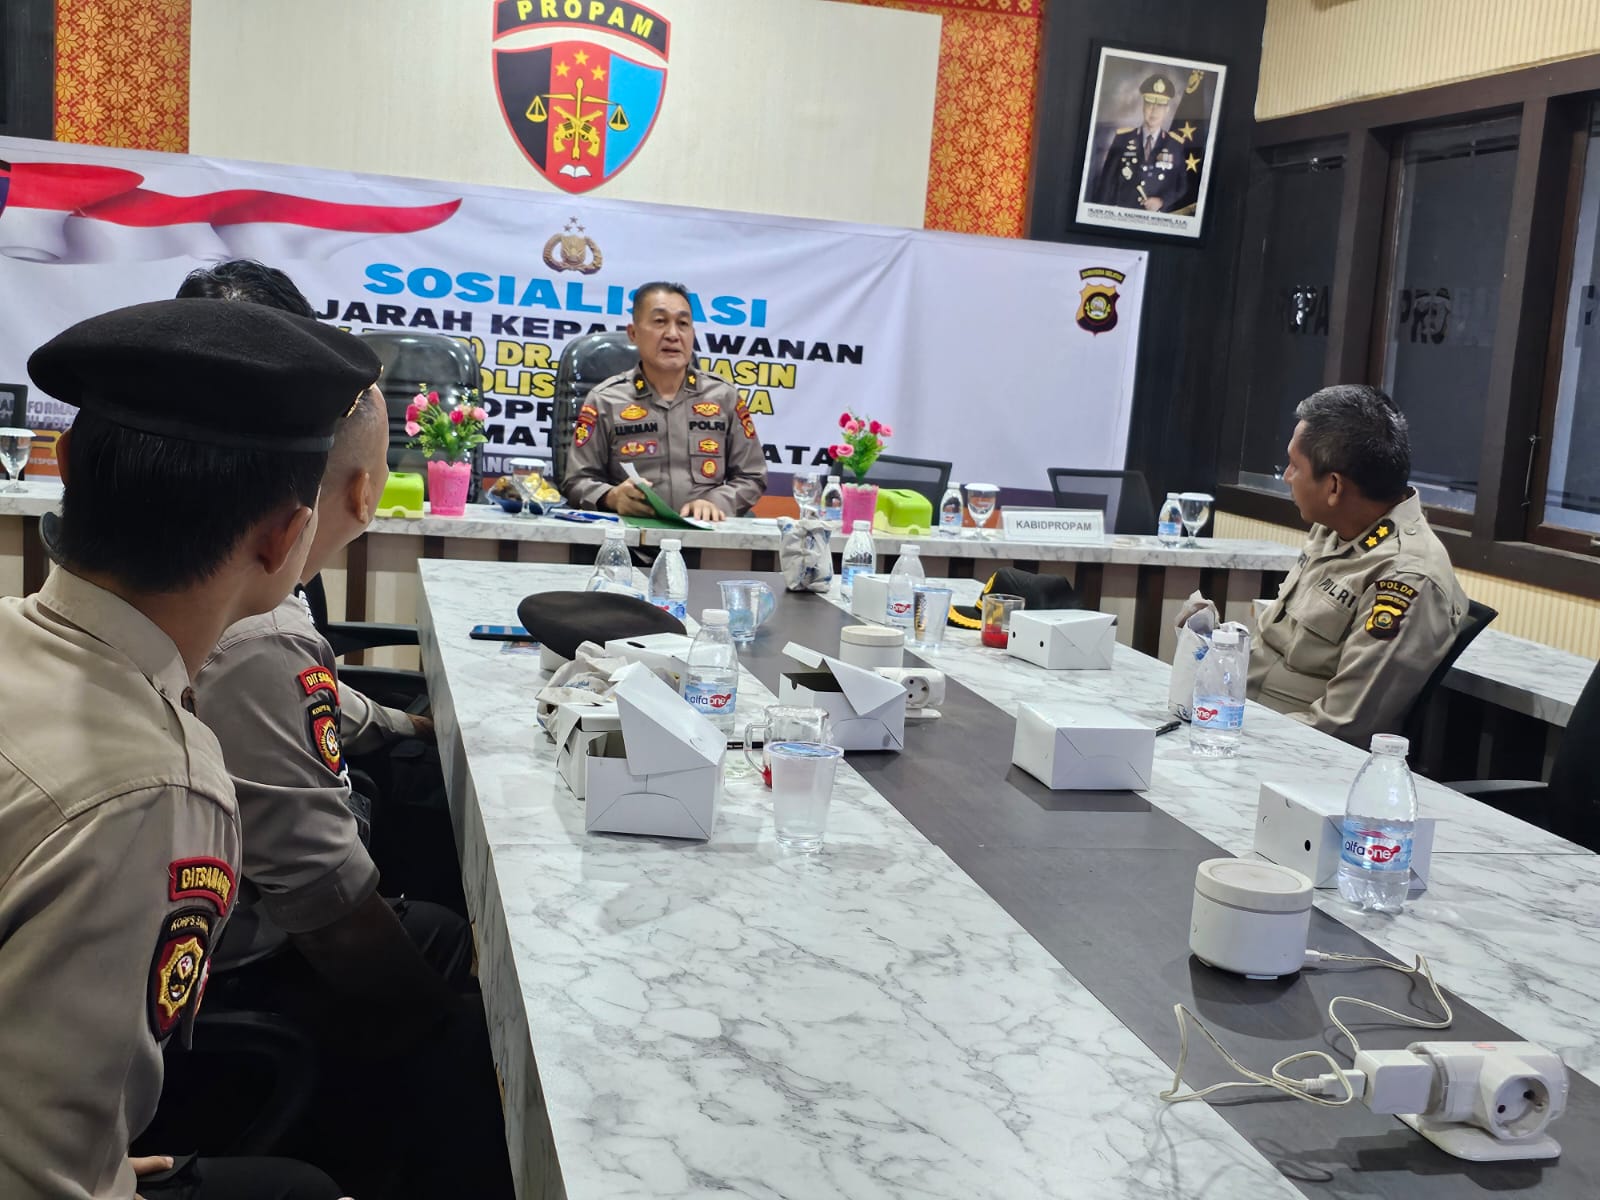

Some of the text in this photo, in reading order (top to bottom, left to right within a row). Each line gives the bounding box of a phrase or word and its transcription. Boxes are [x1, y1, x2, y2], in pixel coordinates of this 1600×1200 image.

[516, 0, 654, 39] PROPAM
[316, 299, 473, 332] JARAH
[496, 339, 560, 370] DR.
[689, 421, 726, 431] POLRI
[1016, 520, 1092, 531] KABIDPROPAM
[1379, 581, 1414, 597] POLDA
